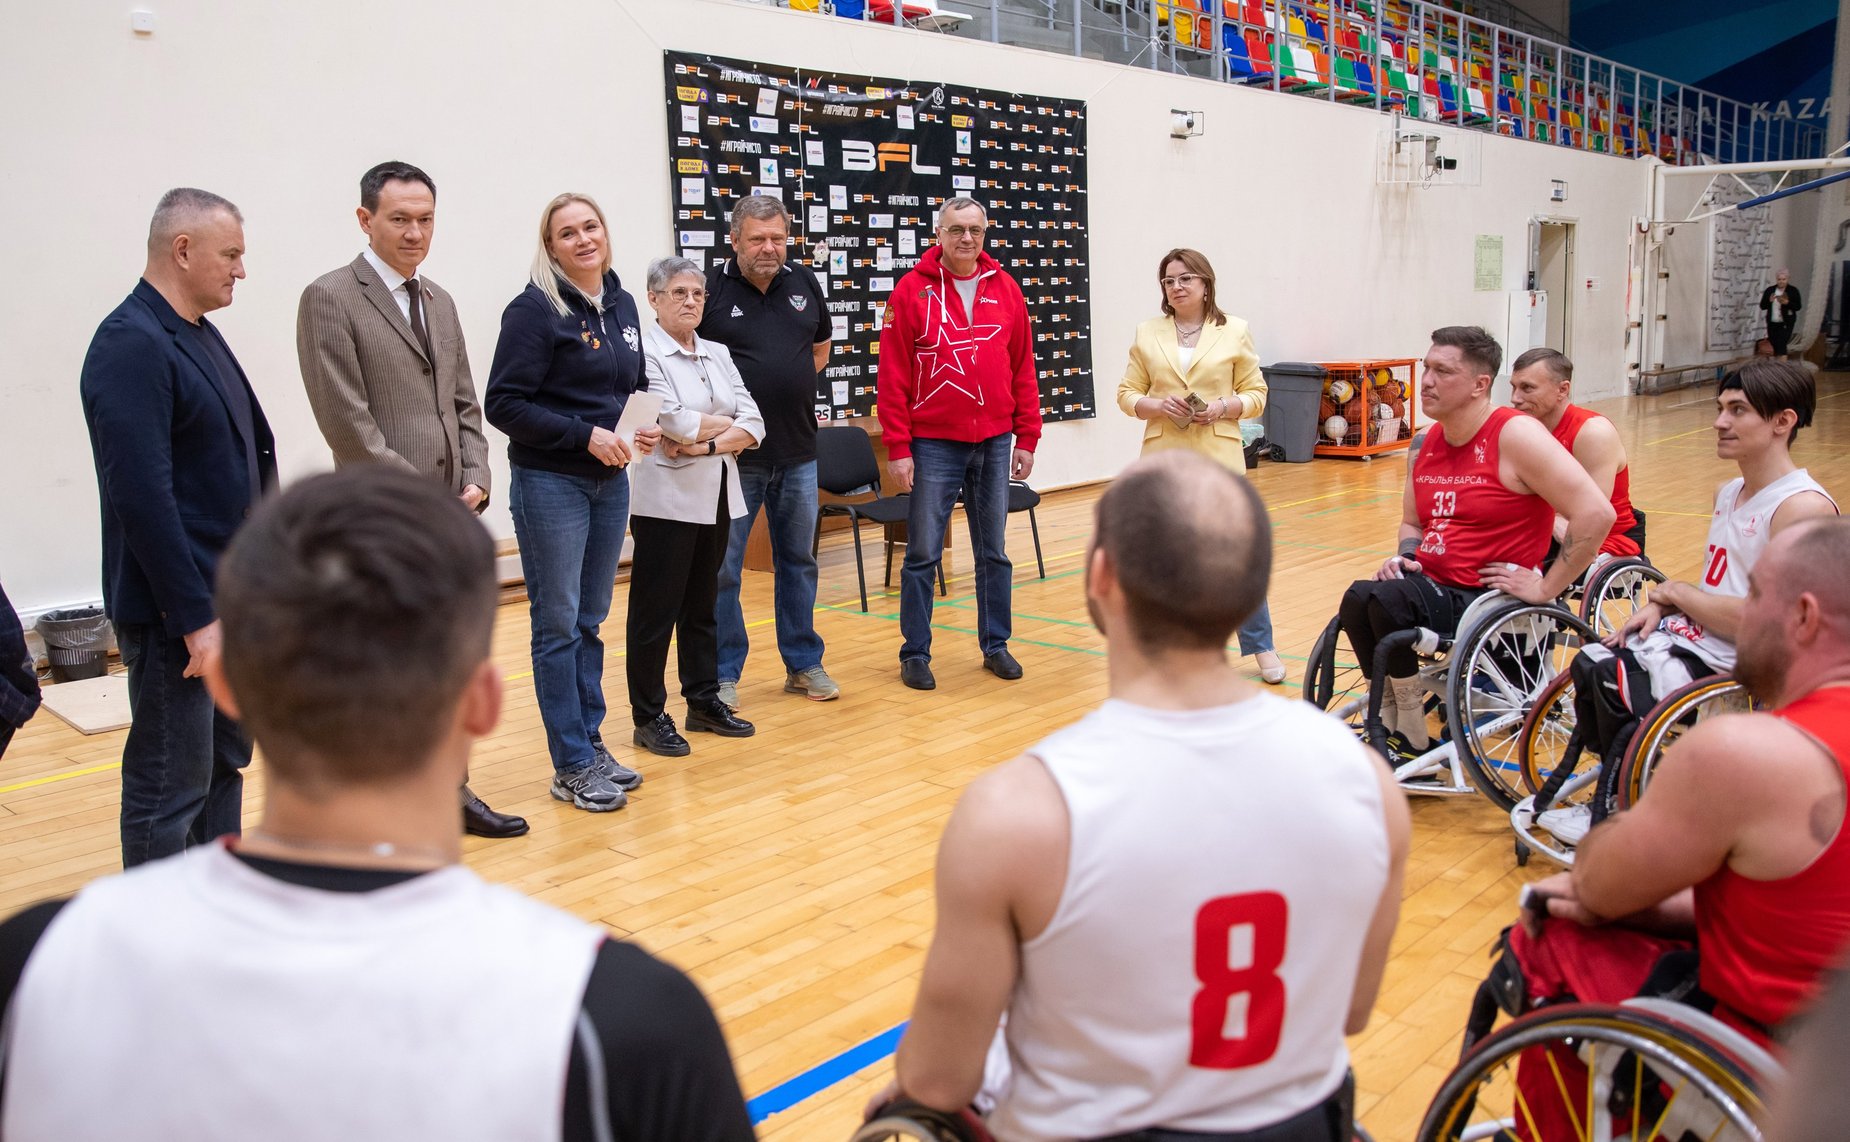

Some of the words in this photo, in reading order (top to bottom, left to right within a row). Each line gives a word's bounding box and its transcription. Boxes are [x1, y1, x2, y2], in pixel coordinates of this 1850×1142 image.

[675, 64, 708, 77] BFL
[720, 69, 762, 84] #ИГРАЙЧИСТО
[769, 77, 798, 88] BFL
[828, 85, 857, 95] BFL
[716, 93, 748, 105] BFL
[901, 92, 924, 102] BFL
[951, 96, 975, 107] BFL
[784, 101, 813, 112] BFL
[979, 100, 1001, 110] BFL
[1010, 104, 1032, 114] BFL
[823, 104, 858, 117] #ИГРАЙЧИСТО
[865, 109, 890, 119] BFL
[1038, 107, 1059, 116] BFL
[1064, 110, 1084, 119] BFL
[707, 116, 740, 127] BFL
[920, 113, 943, 123] BFL
[790, 124, 818, 134] BFL
[990, 121, 1012, 130] BFL
[1022, 124, 1042, 133] BFL
[1052, 127, 1072, 136] BFL
[678, 137, 709, 148] BFL
[720, 140, 761, 154] #ИГРАЙЧИСТО
[980, 140, 1002, 149] BFL
[770, 145, 799, 155] BFL
[1011, 143, 1032, 152] BFL
[1039, 145, 1058, 154] BFL
[1064, 148, 1085, 156] BFL
[842, 140, 940, 175] BFL
[952, 158, 976, 167] BFL
[990, 161, 1012, 170] BFL
[718, 164, 752, 175] BFL
[1022, 163, 1042, 172] BFL
[1052, 165, 1071, 174] BFL
[785, 169, 814, 178] BFL
[980, 180, 1002, 188] BFL
[1011, 182, 1031, 190] BFL
[712, 187, 740, 198] BFL
[1065, 185, 1086, 193] BFL
[794, 191, 822, 201] BFL
[854, 194, 880, 203] BFL
[888, 194, 919, 206] #ИГРАЙЧИСТО
[990, 200, 1012, 208] BFL
[679, 210, 715, 220] BFL
[834, 216, 860, 224] BFL
[900, 217, 926, 226] BFL
[868, 238, 892, 246] BFL
[833, 281, 860, 289] BFL
[834, 345, 861, 354] BFL
[826, 366, 860, 377] #ИГРАЙЧИСТО
[1040, 370, 1058, 378] BFL
[1064, 368, 1088, 376] BFL
[1052, 387, 1072, 395] BFL
[1040, 407, 1058, 415] BFL
[1065, 404, 1091, 412] BFL
[837, 409, 862, 419] BFL
[1416, 475, 1452, 484] «КРЫЛЬЯ
[1454, 476, 1487, 485] БАРСА»
[1432, 491, 1456, 517] 33
[1189, 890, 1287, 1070] 8
